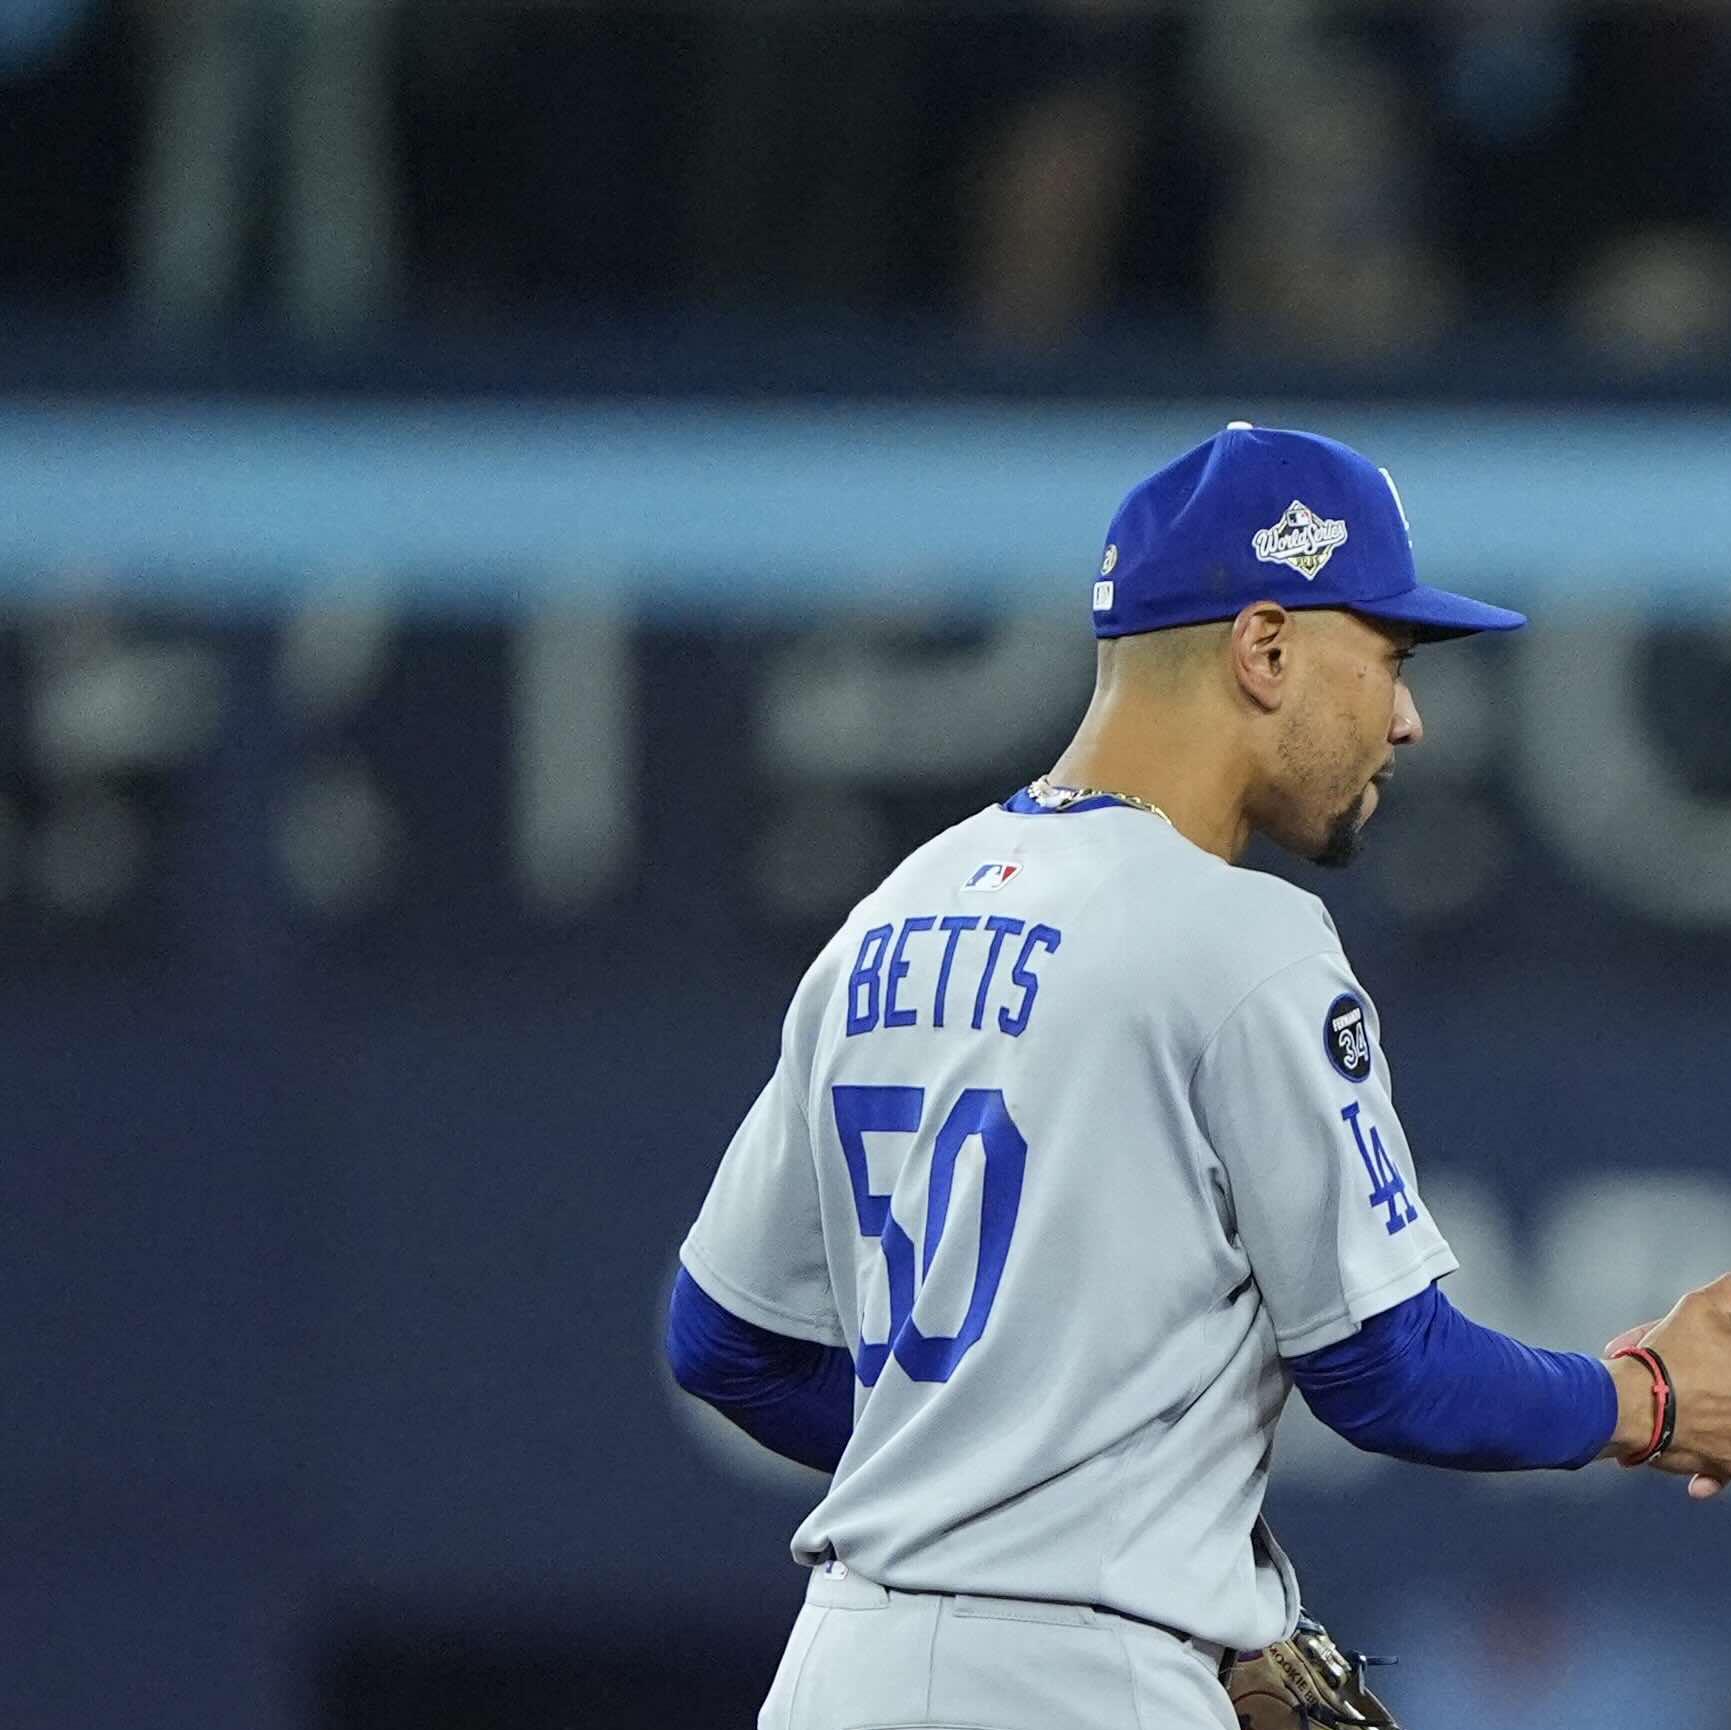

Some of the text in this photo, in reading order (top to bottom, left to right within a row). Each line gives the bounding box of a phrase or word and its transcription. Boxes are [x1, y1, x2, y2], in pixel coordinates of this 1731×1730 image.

[846, 915, 1061, 1037] BETTS
[1339, 1022, 1369, 1069] 34
[1341, 1101, 1418, 1236] LA
[832, 1085, 1028, 1388] 50
